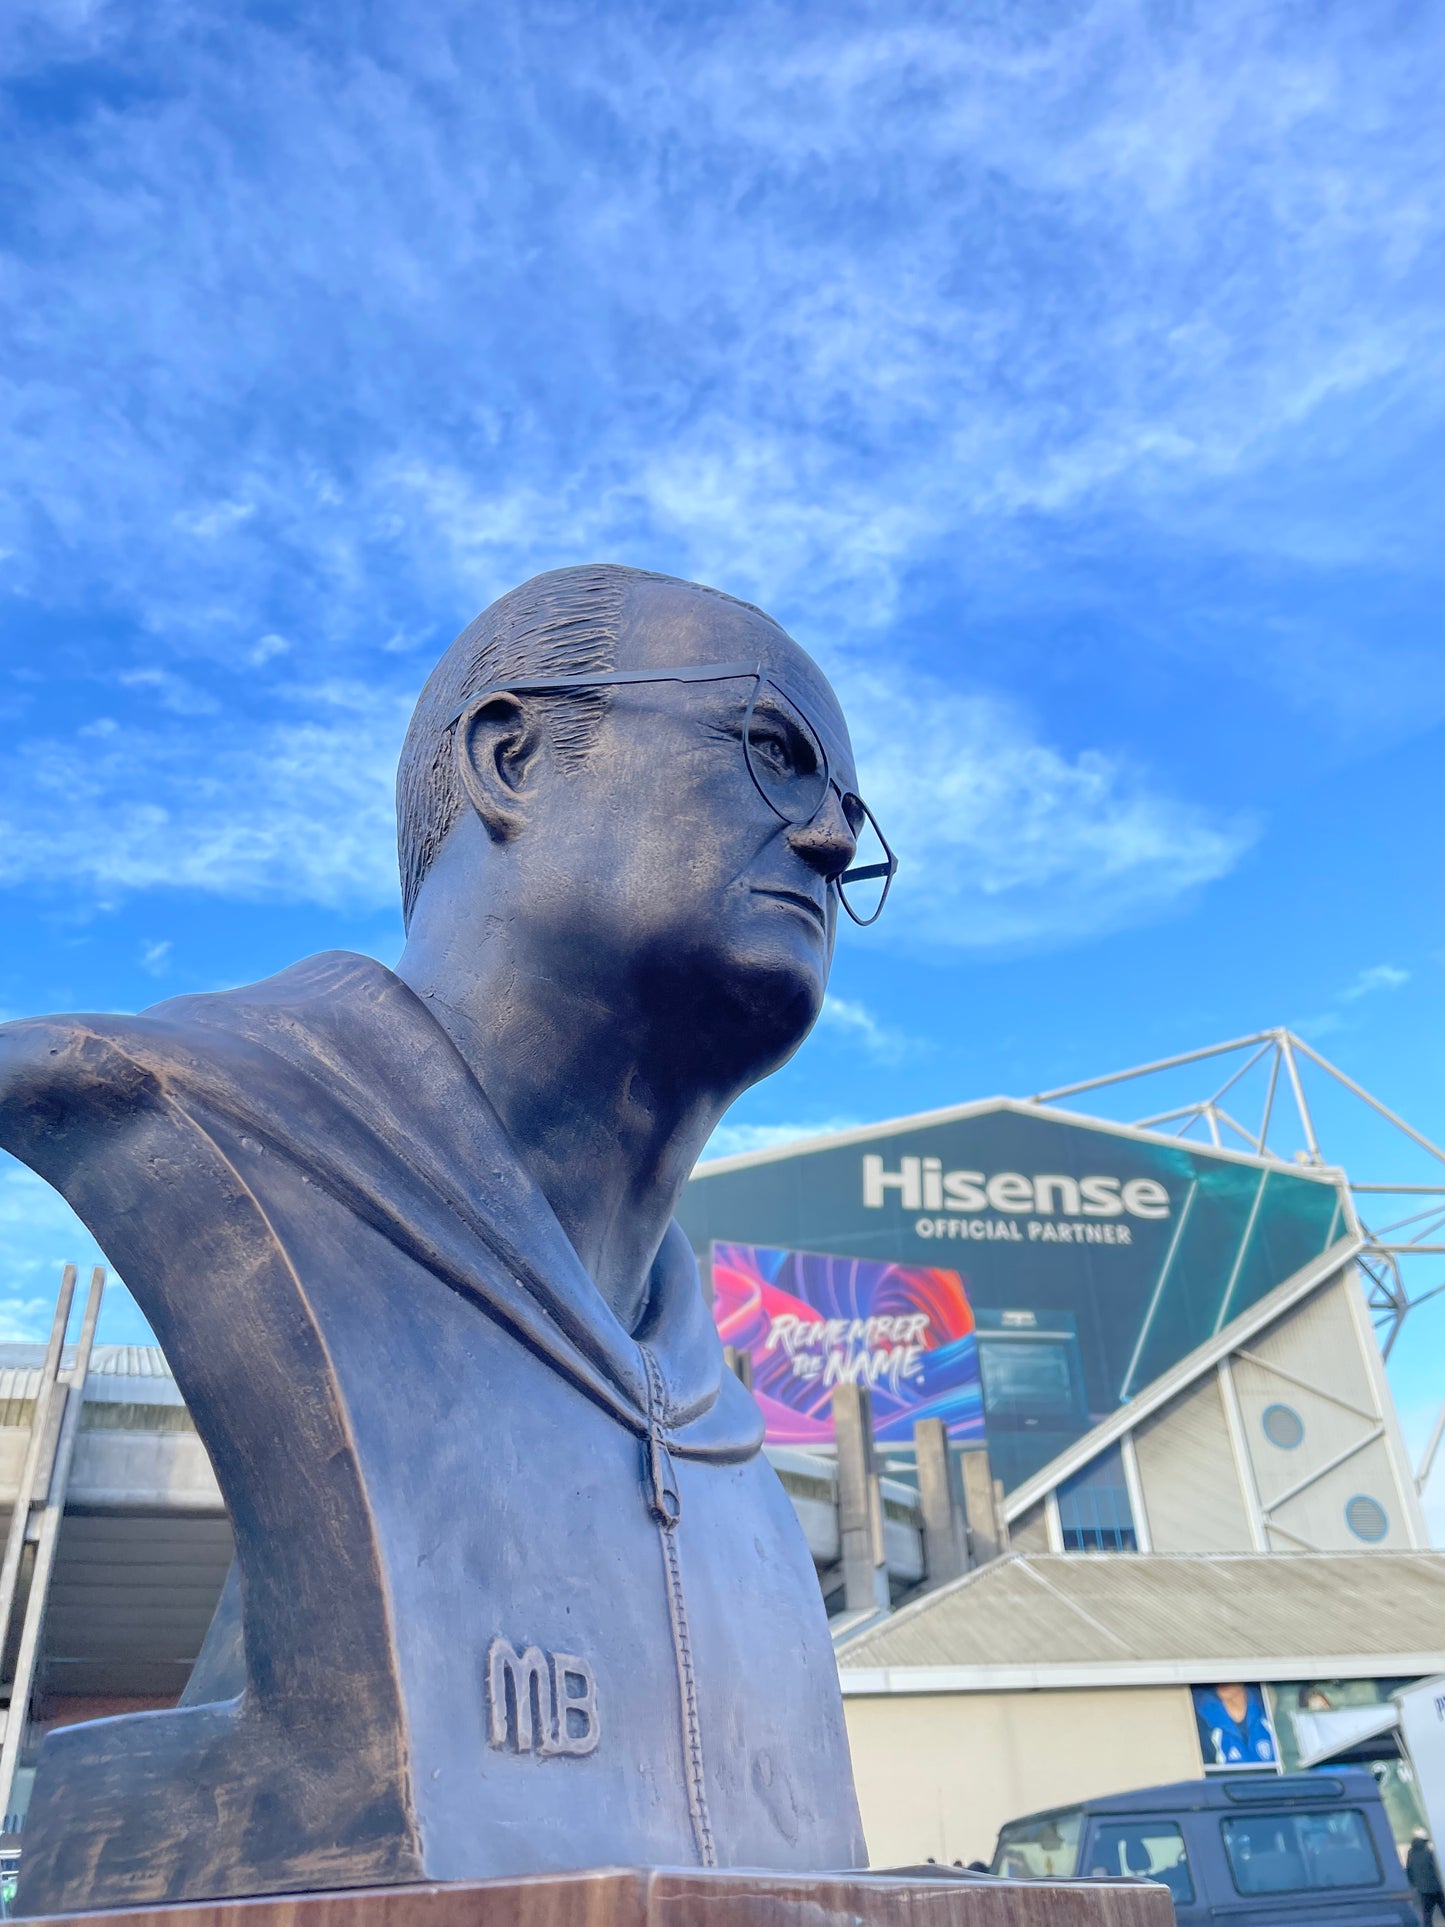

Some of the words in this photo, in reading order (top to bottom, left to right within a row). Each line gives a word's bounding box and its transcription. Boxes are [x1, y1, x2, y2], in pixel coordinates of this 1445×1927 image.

[862, 1154, 1170, 1219] Hisense
[915, 1217, 1023, 1241] OFFICIAL
[1028, 1221, 1134, 1245] PARTNER
[765, 1313, 930, 1357] REMEMBER
[485, 1637, 601, 1756] MB
